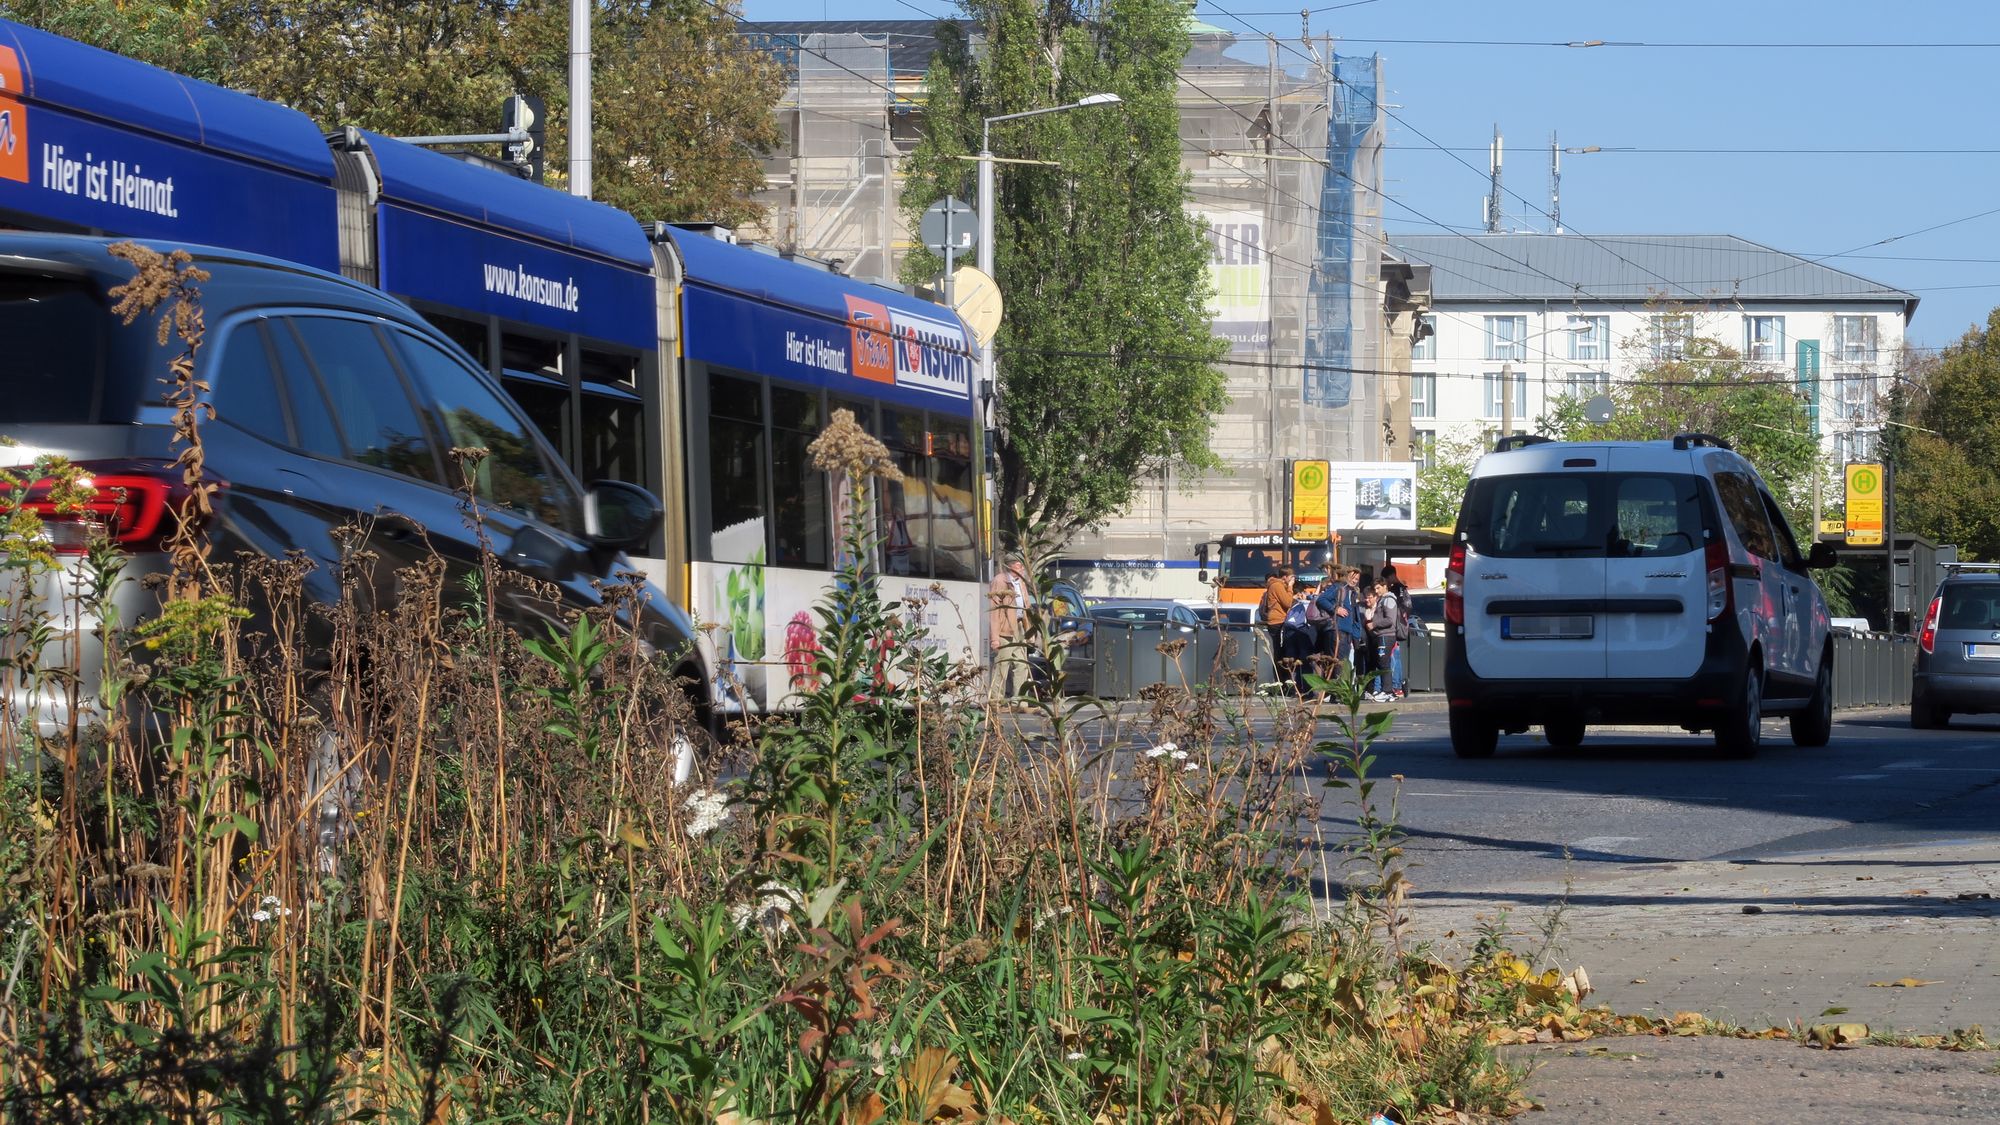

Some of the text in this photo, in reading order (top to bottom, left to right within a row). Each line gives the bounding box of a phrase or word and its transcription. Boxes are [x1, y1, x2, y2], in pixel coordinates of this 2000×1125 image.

[43, 143, 178, 218] Hier ist Heimat.
[484, 264, 579, 312] www.konsum.de
[786, 330, 848, 375] Hier ist Heimat.
[1236, 535, 1270, 545] Ronald
